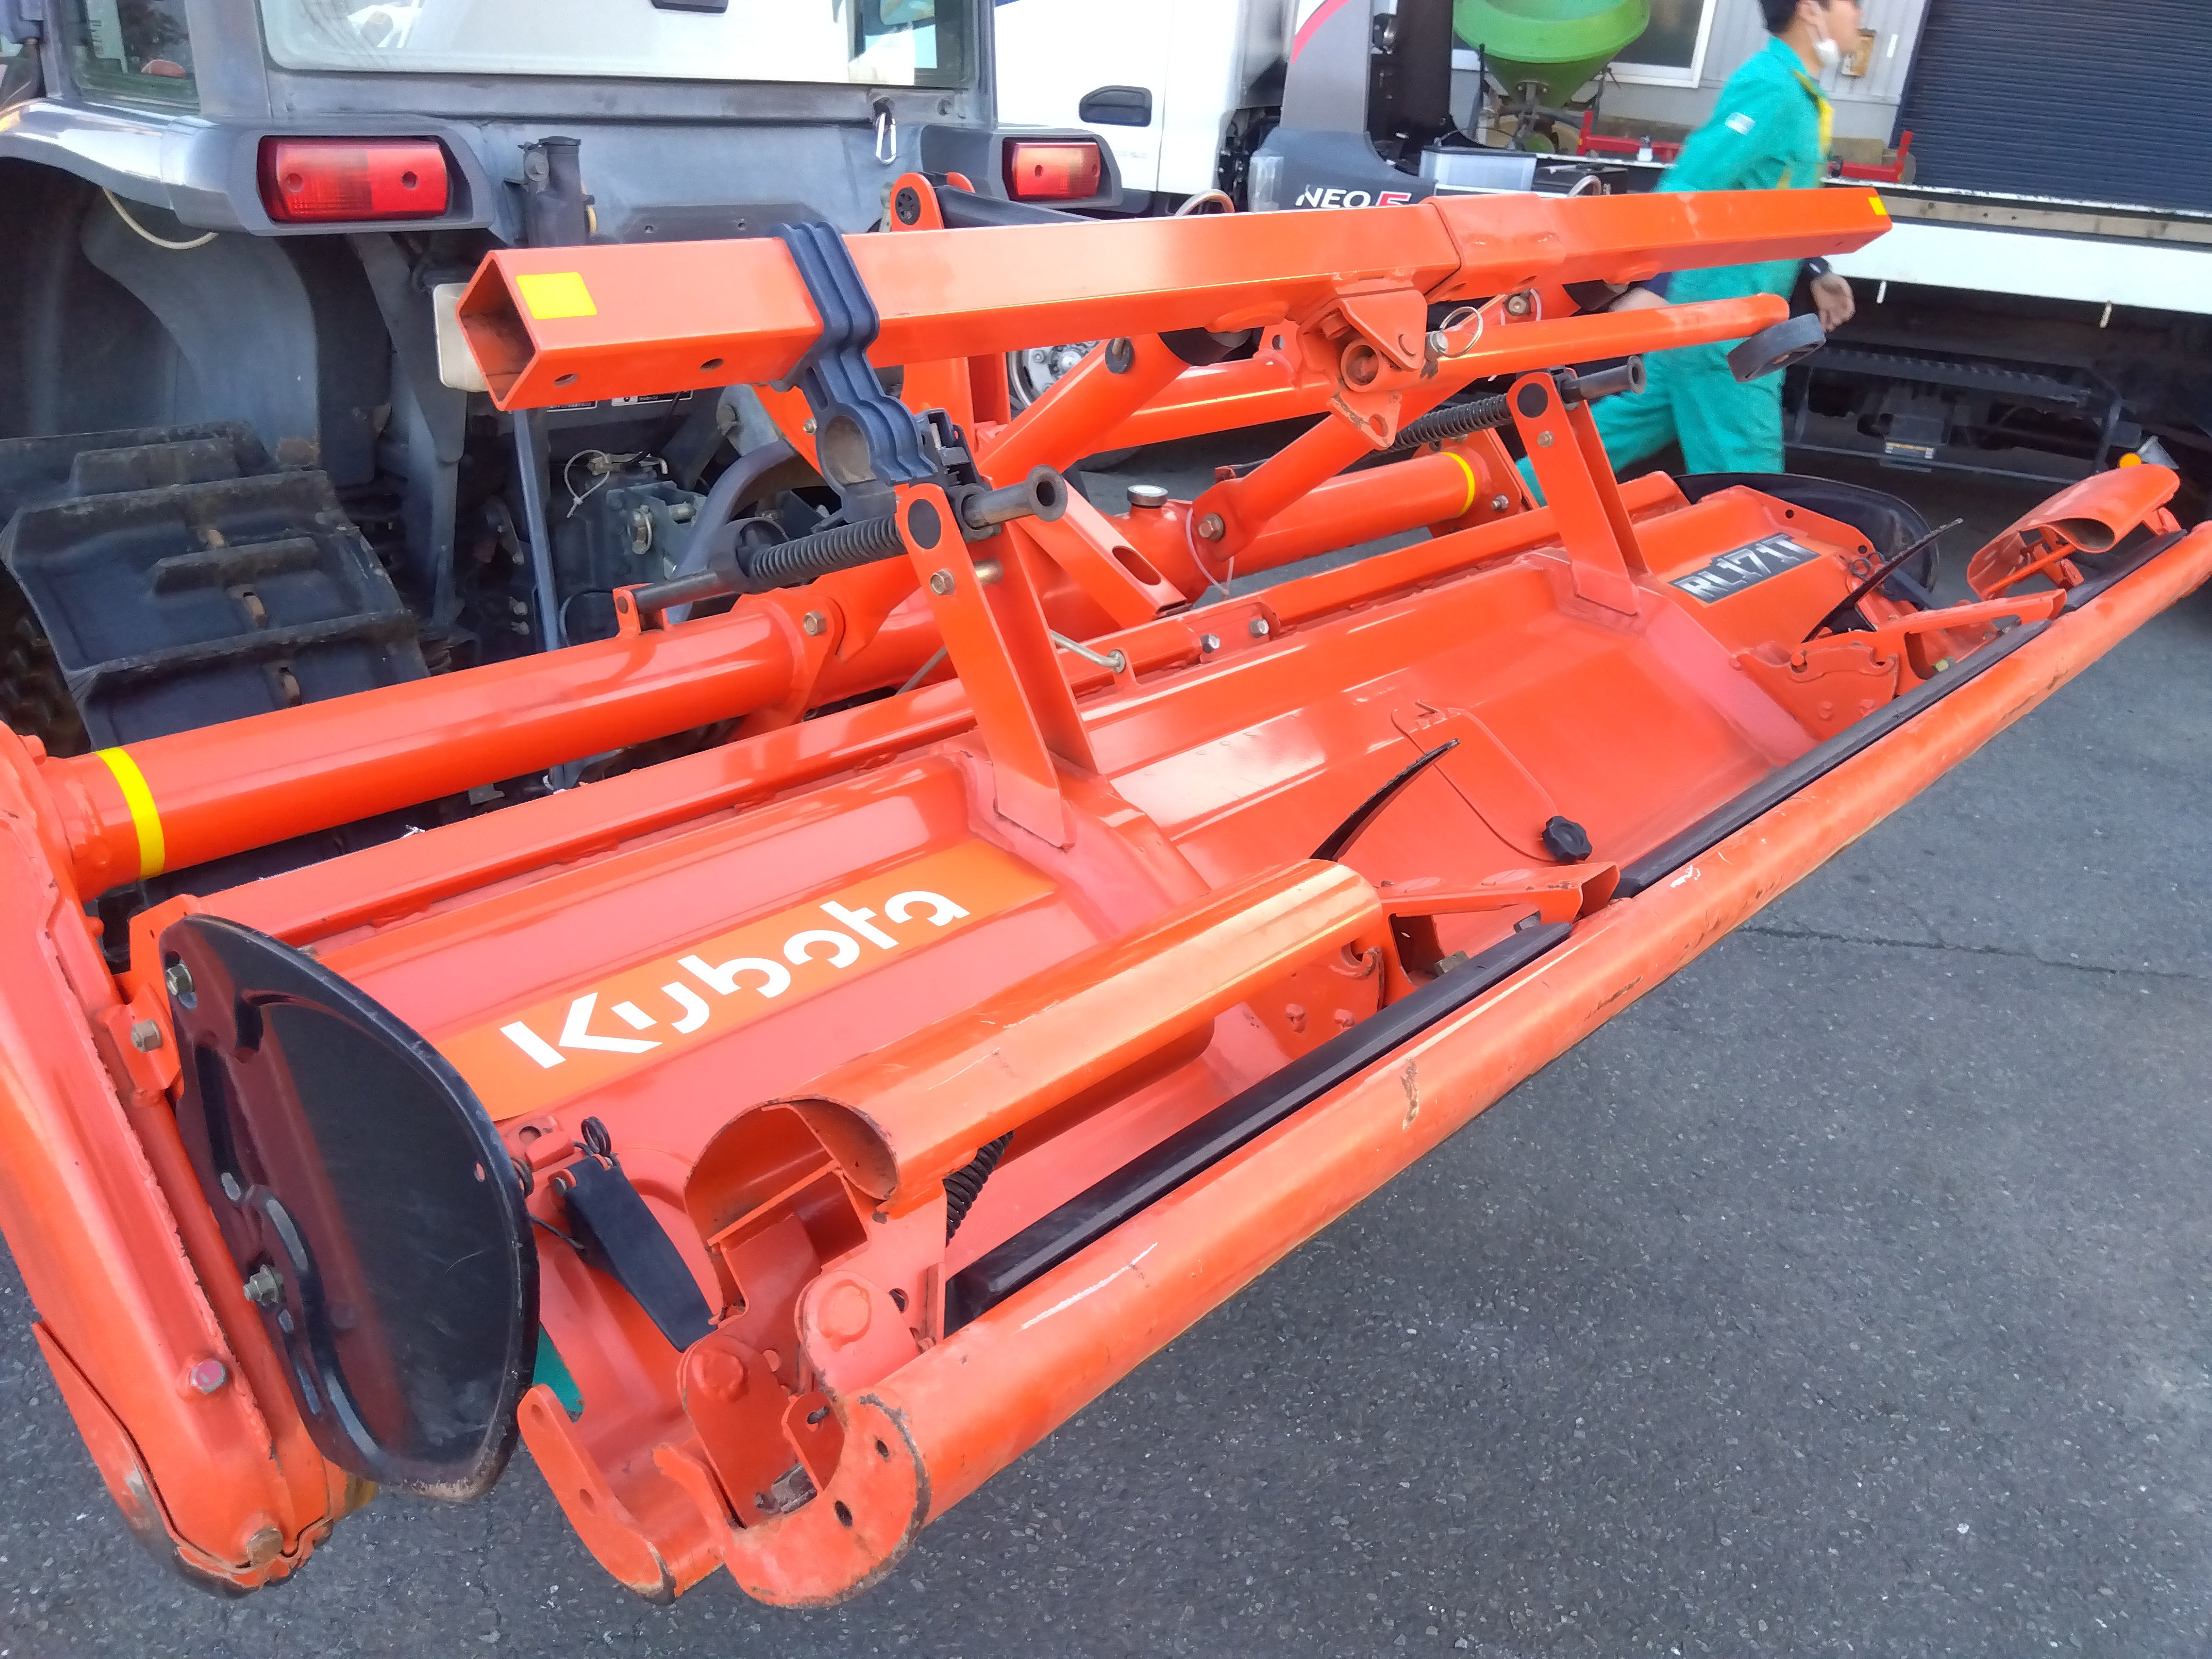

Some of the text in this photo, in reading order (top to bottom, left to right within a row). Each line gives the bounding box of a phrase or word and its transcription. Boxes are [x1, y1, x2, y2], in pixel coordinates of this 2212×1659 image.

[1295, 185, 1371, 208] NEO
[1674, 533, 1816, 598] RL171T
[500, 891, 970, 1068] Kubota
